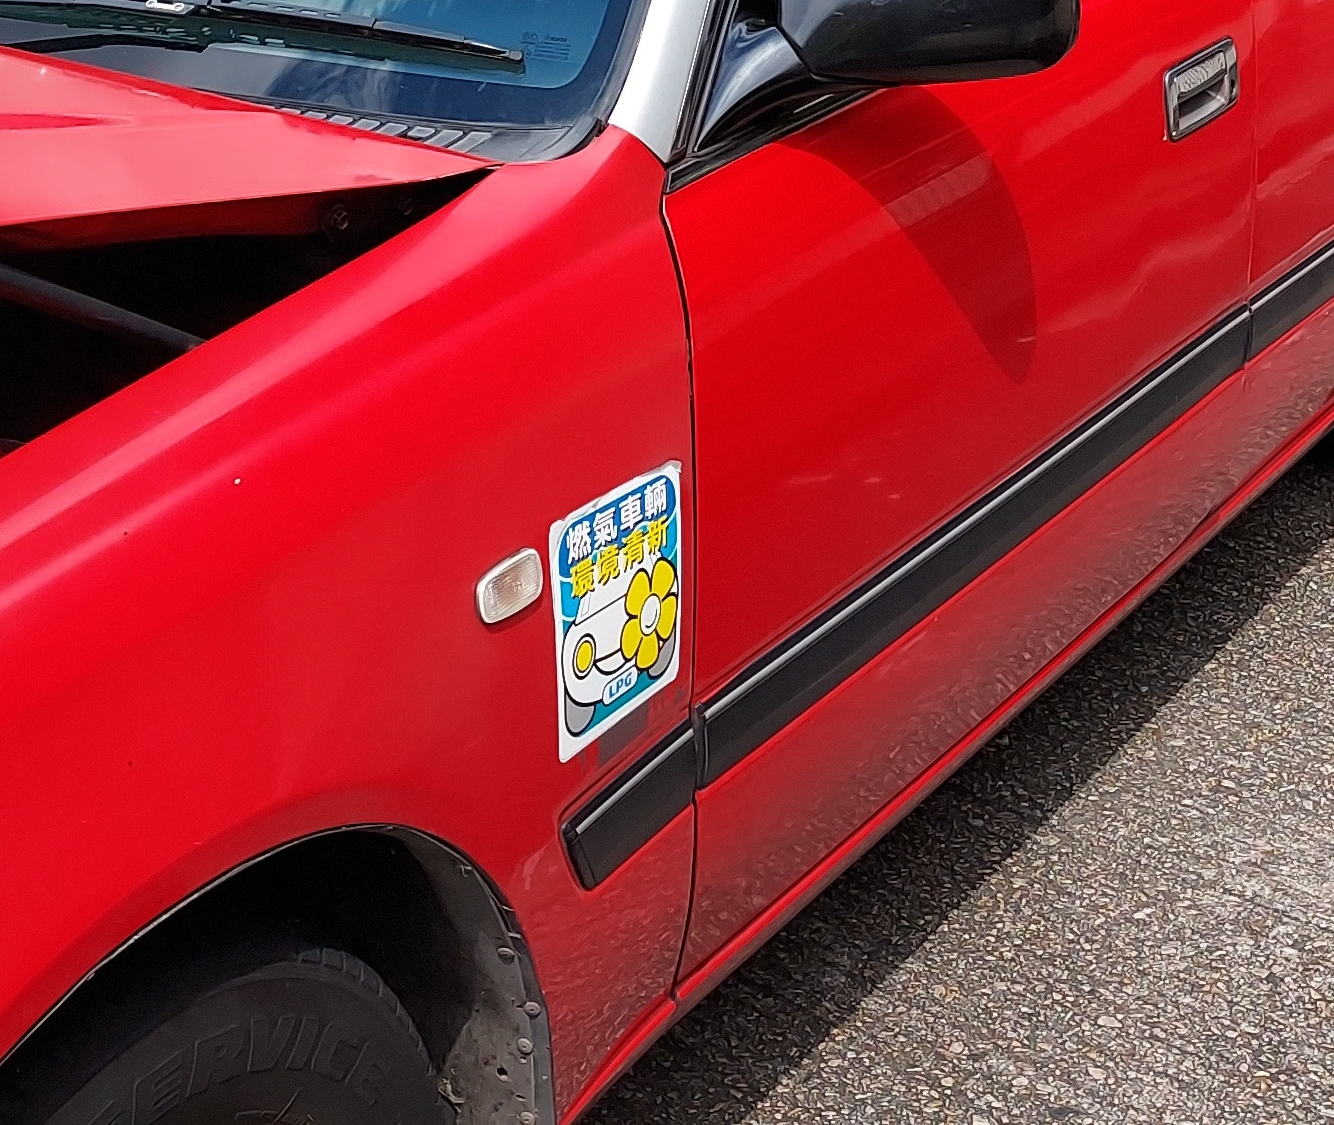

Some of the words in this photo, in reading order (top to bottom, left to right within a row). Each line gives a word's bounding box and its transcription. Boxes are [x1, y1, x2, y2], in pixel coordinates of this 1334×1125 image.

[566, 477, 667, 564] 燃氣車輛
[569, 516, 667, 599] 環境清新
[608, 673, 633, 700] LPG
